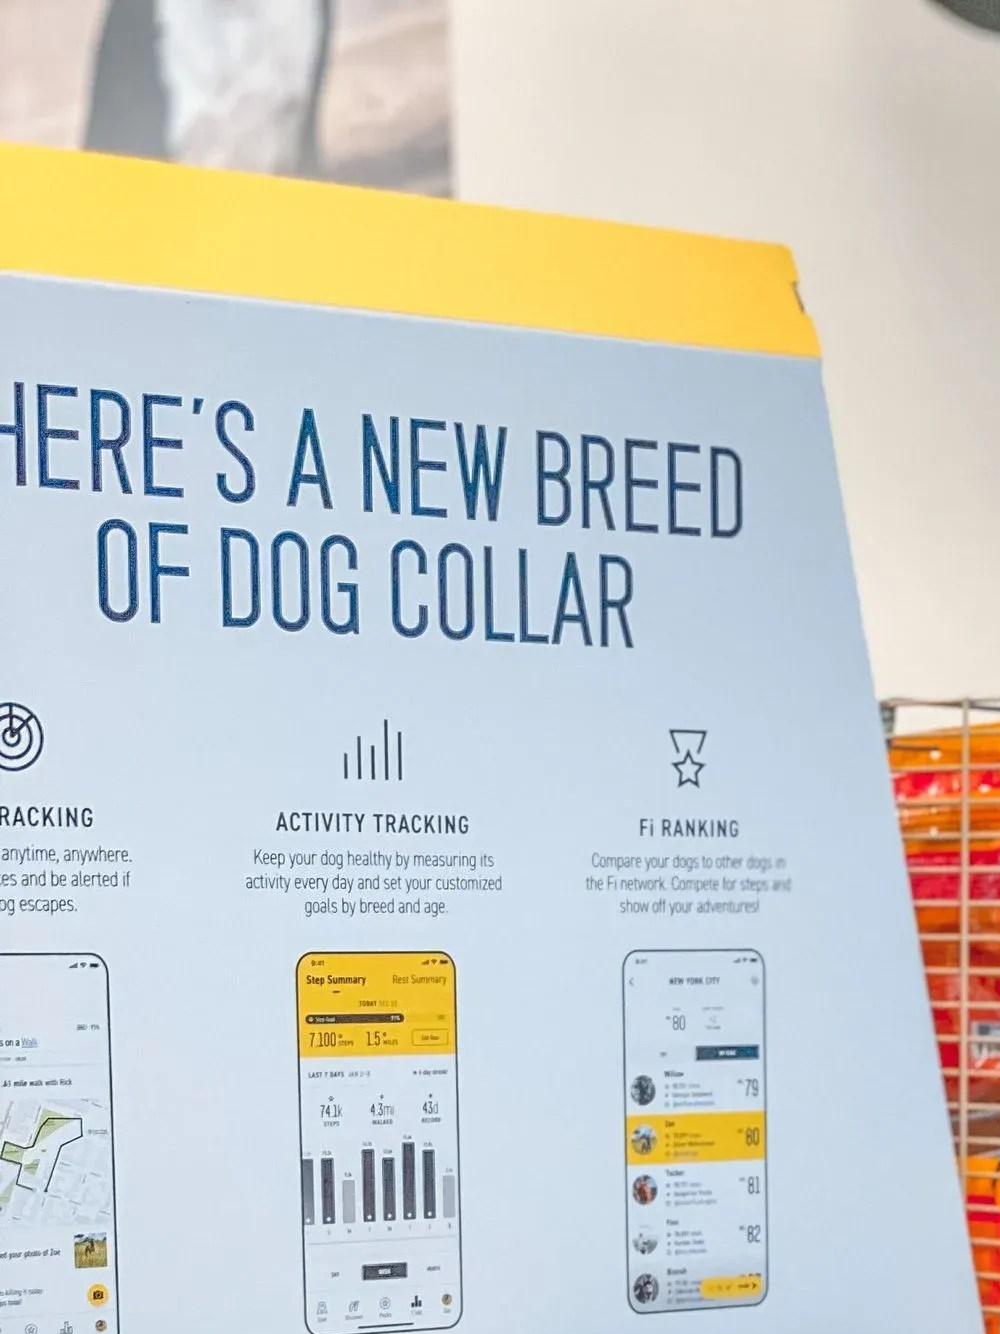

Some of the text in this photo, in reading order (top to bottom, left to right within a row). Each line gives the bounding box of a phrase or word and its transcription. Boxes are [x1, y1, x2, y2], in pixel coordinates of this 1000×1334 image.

[286, 408, 334, 510] A
[362, 413, 508, 522] NEW
[536, 430, 744, 539] BREED
[97, 518, 635, 649] OF DOG COLLAR
[276, 812, 470, 834] ACTIVITY TRACKING
[638, 818, 740, 838] Fi RANKING
[2, 844, 133, 866] anytime, anywhere.
[253, 849, 495, 870] Keep your dog healthy by measuring its
[591, 852, 642, 871] Compare
[644, 855, 670, 872] your
[672, 855, 699, 872] dogs
[702, 855, 713, 869] to
[715, 855, 743, 869] other
[746, 855, 772, 873] dogs
[21, 870, 131, 888] and be alerted if
[245, 874, 502, 893] activity every day and set your customized
[586, 876, 604, 890] the
[607, 875, 617, 890] Fi
[671, 875, 719, 893] Compete
[722, 876, 736, 891] for
[740, 877, 769, 894] steps
[19, 899, 78, 916] escapes.
[304, 899, 449, 917] goals by breed and age.
[620, 899, 649, 914] show
[652, 899, 666, 914] off
[669, 902, 693, 916] your
[306, 975, 366, 986] Step Summary
[392, 975, 447, 986] Rest Summary
[672, 1015, 686, 1031] 80
[745, 1079, 759, 1097] 79
